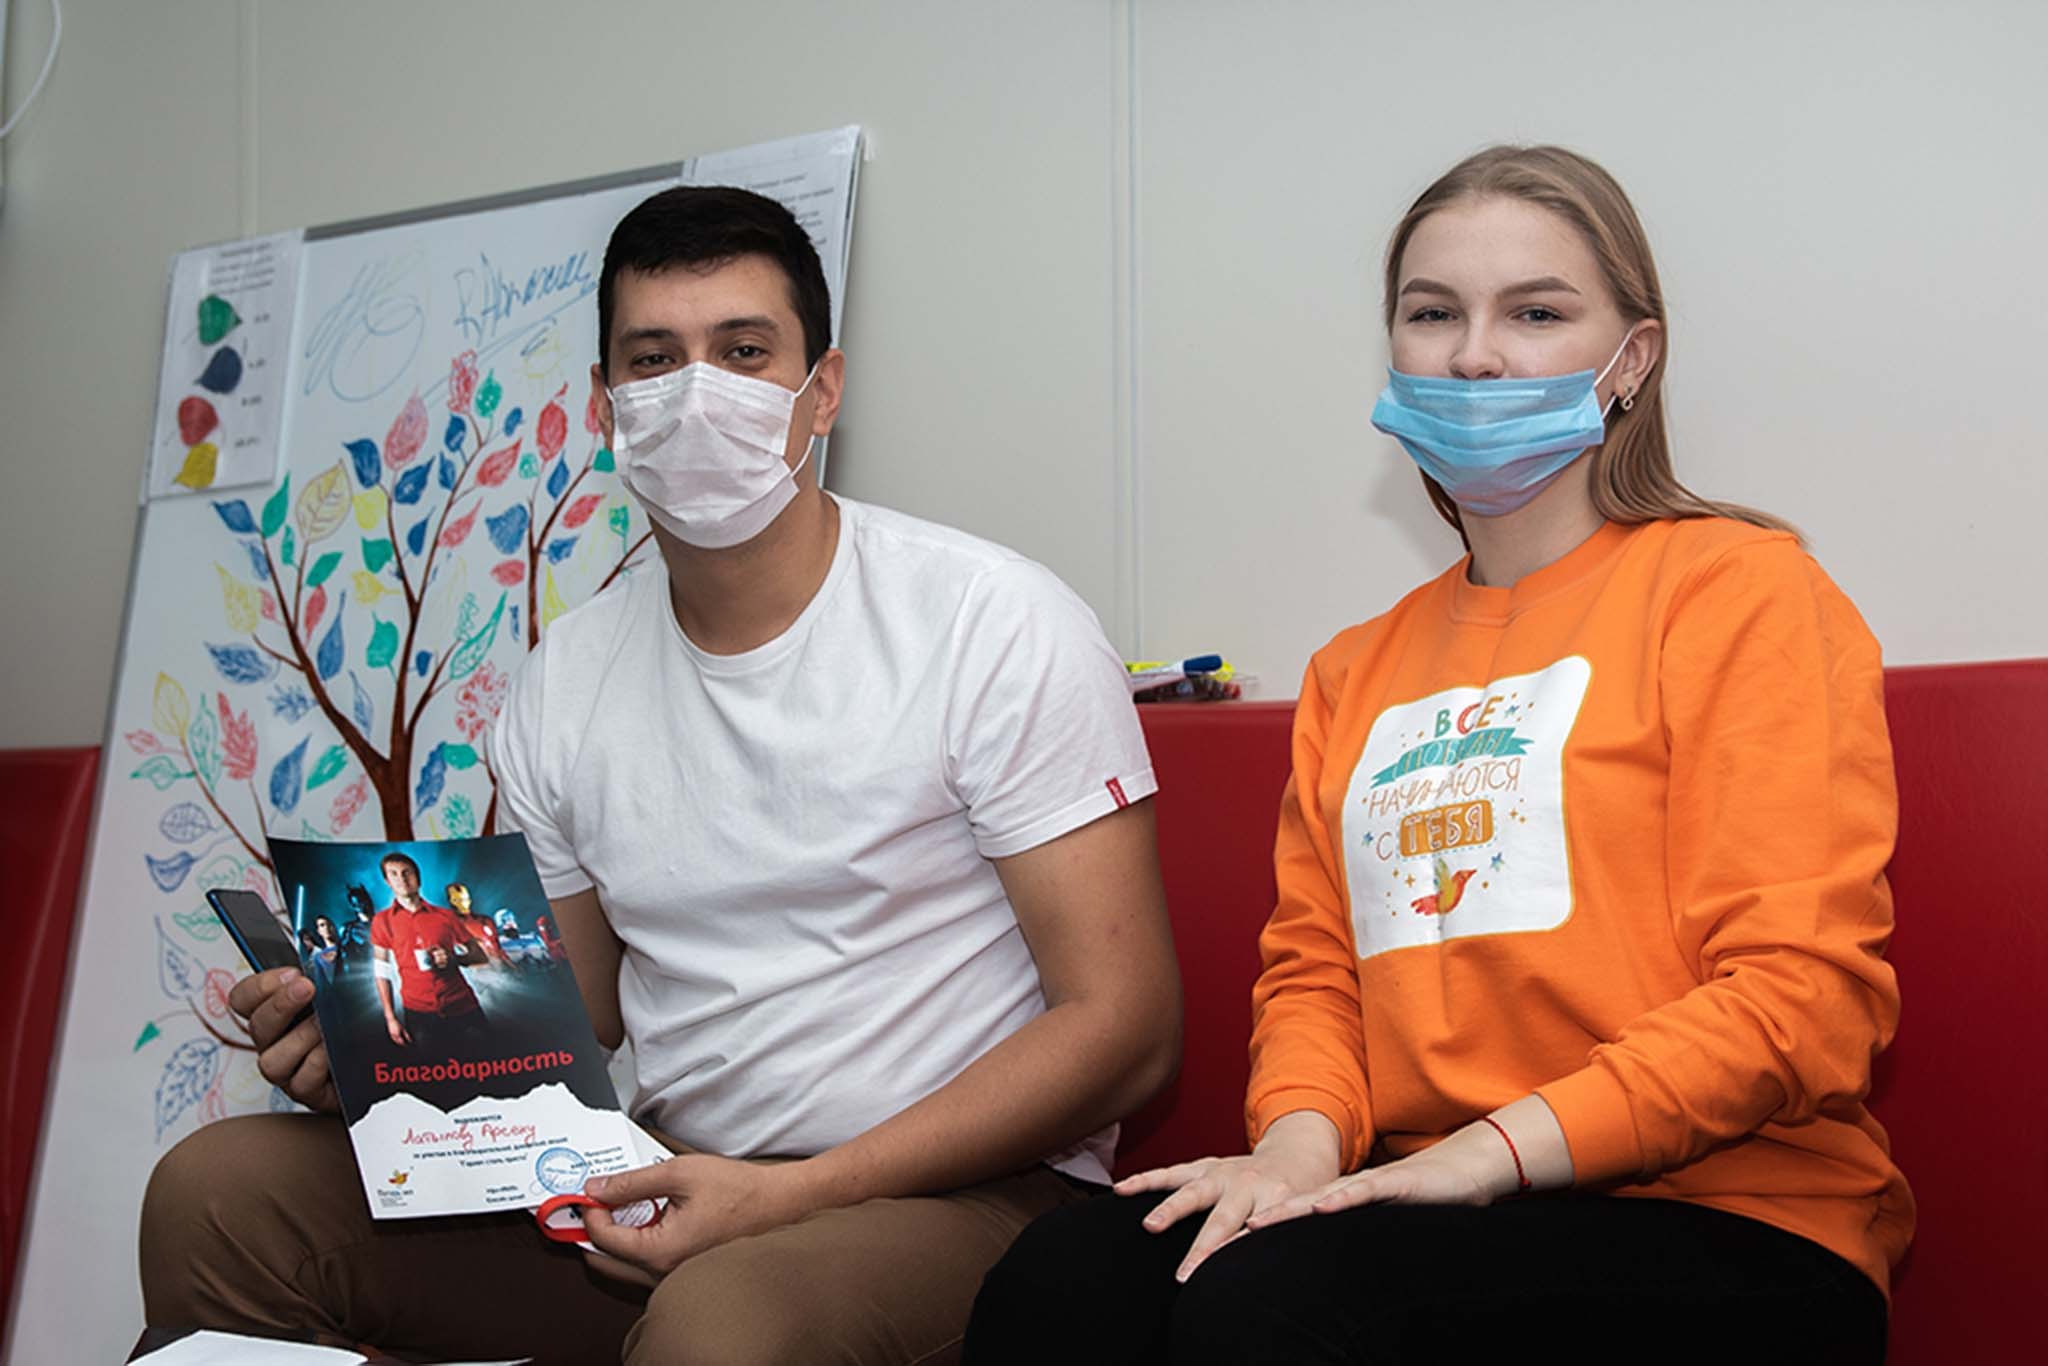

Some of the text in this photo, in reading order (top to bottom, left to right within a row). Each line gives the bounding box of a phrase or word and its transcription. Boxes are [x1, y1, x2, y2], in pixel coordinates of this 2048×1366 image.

[1435, 696, 1504, 738] ВСЕ
[1405, 731, 1507, 771] ПОБДЫ
[1368, 757, 1520, 818] НАЧИНАЮТСЯ
[1376, 803, 1484, 861] С ТЕБЯ
[374, 1050, 574, 1084] Благодарность
